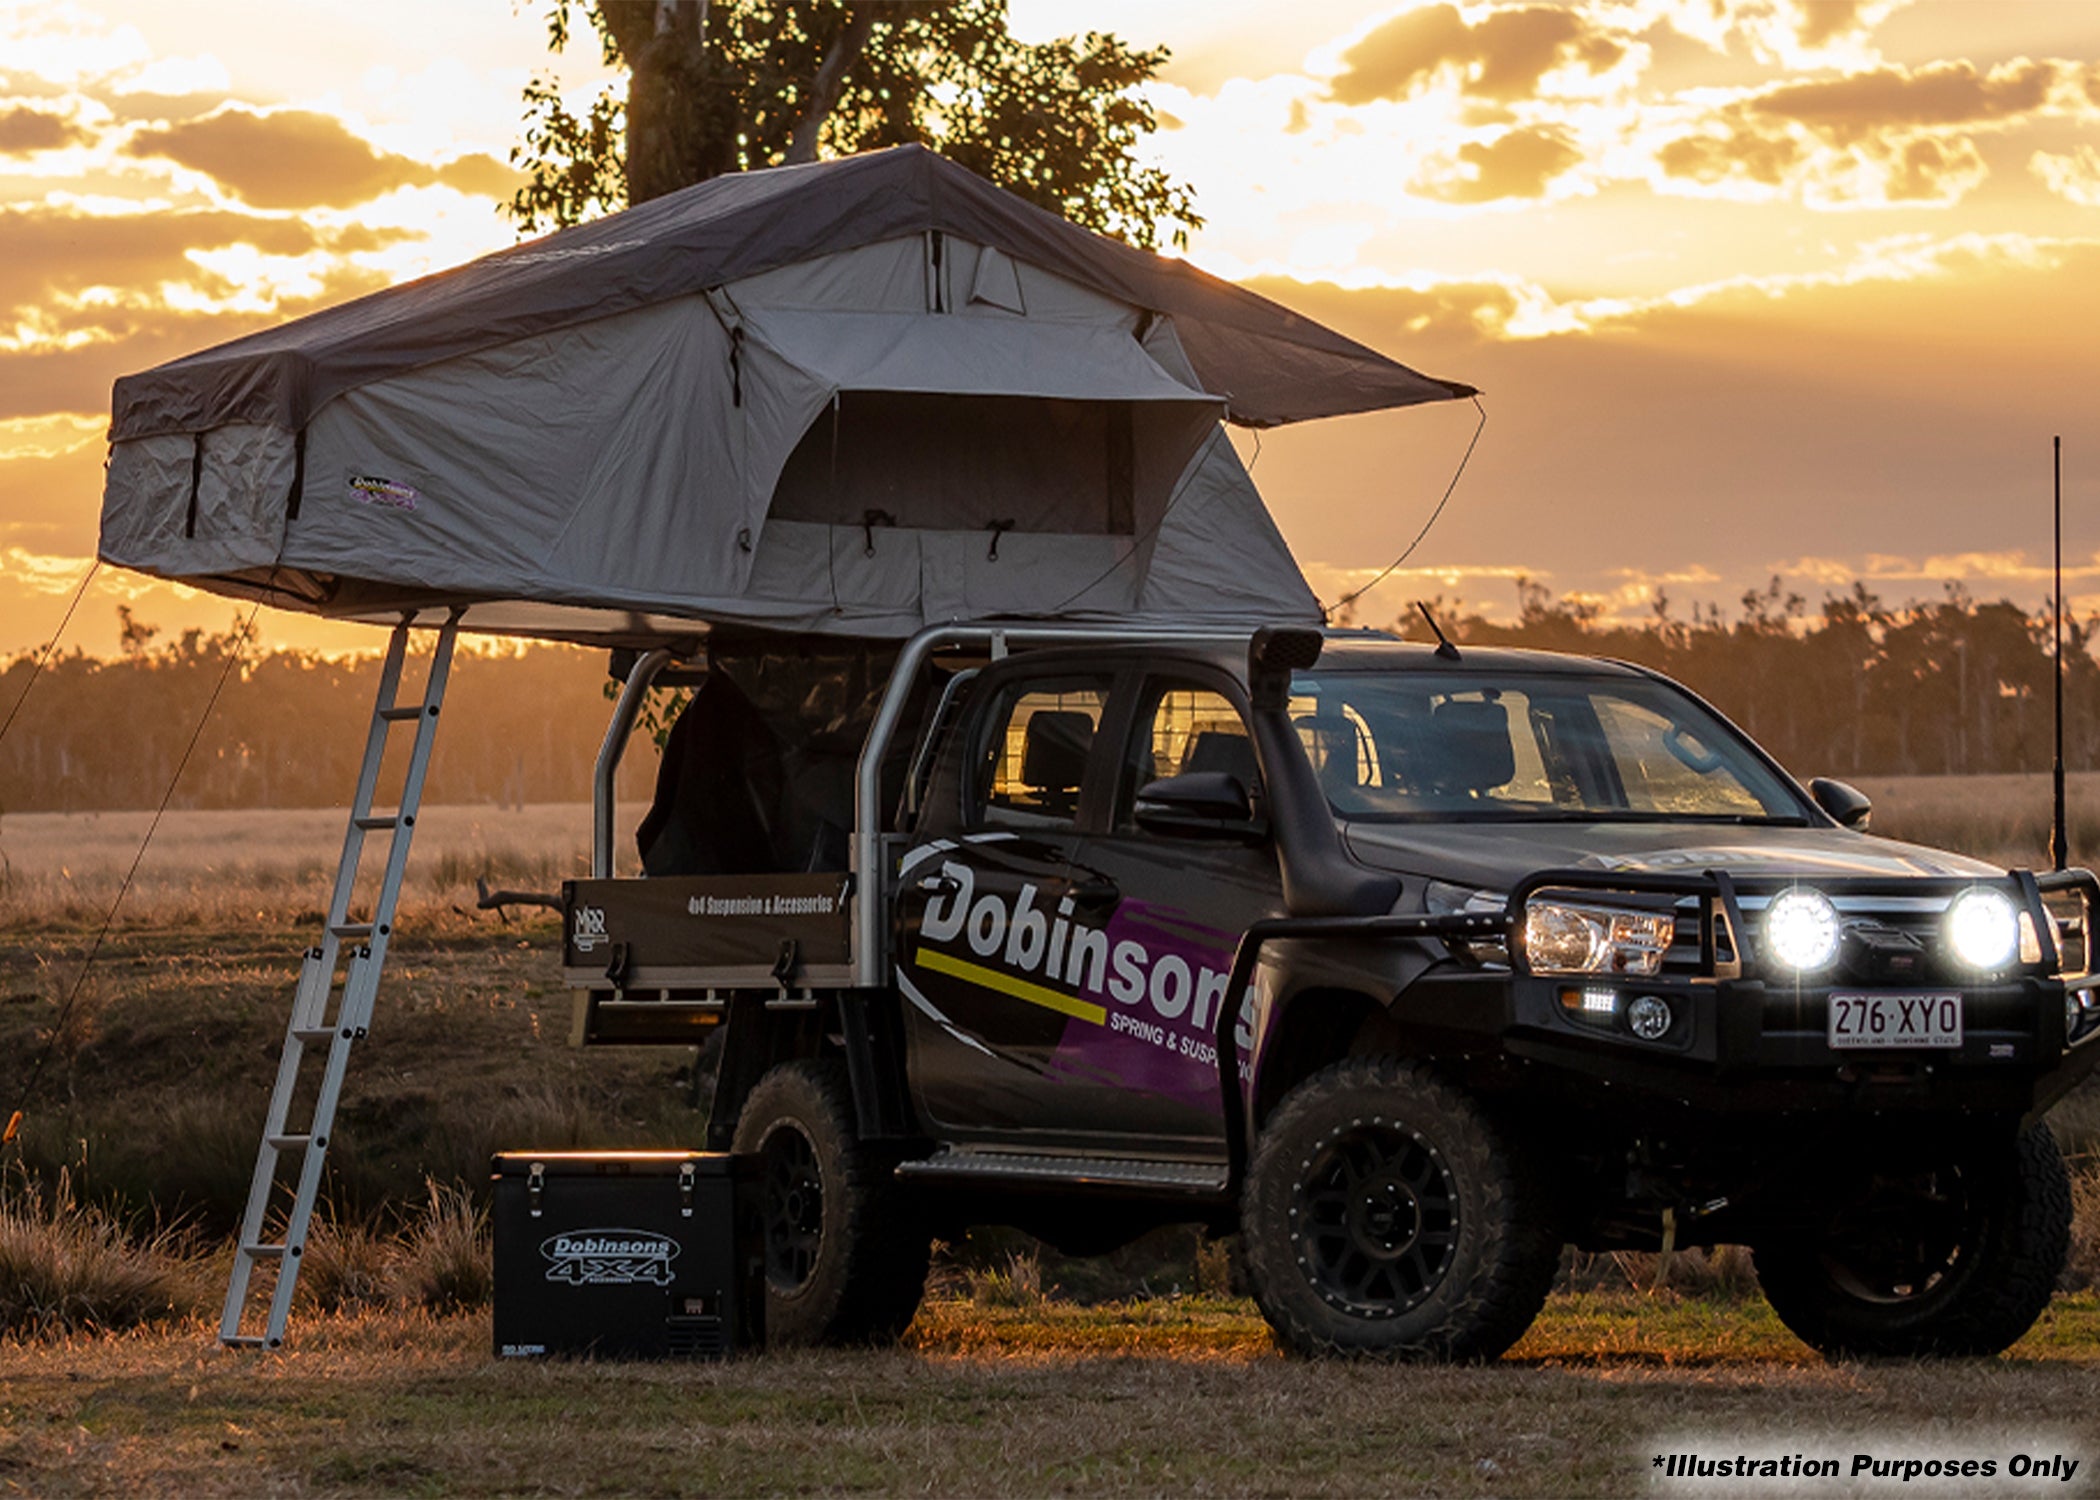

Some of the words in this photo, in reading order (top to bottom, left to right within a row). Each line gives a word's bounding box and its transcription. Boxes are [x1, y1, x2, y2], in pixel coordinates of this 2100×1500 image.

[707, 895, 762, 917] Suspension
[773, 893, 833, 915] Accessories
[1110, 1012, 1164, 1046] SPRING
[1166, 1031, 1177, 1051] &
[555, 1238, 669, 1253] Dobinsons
